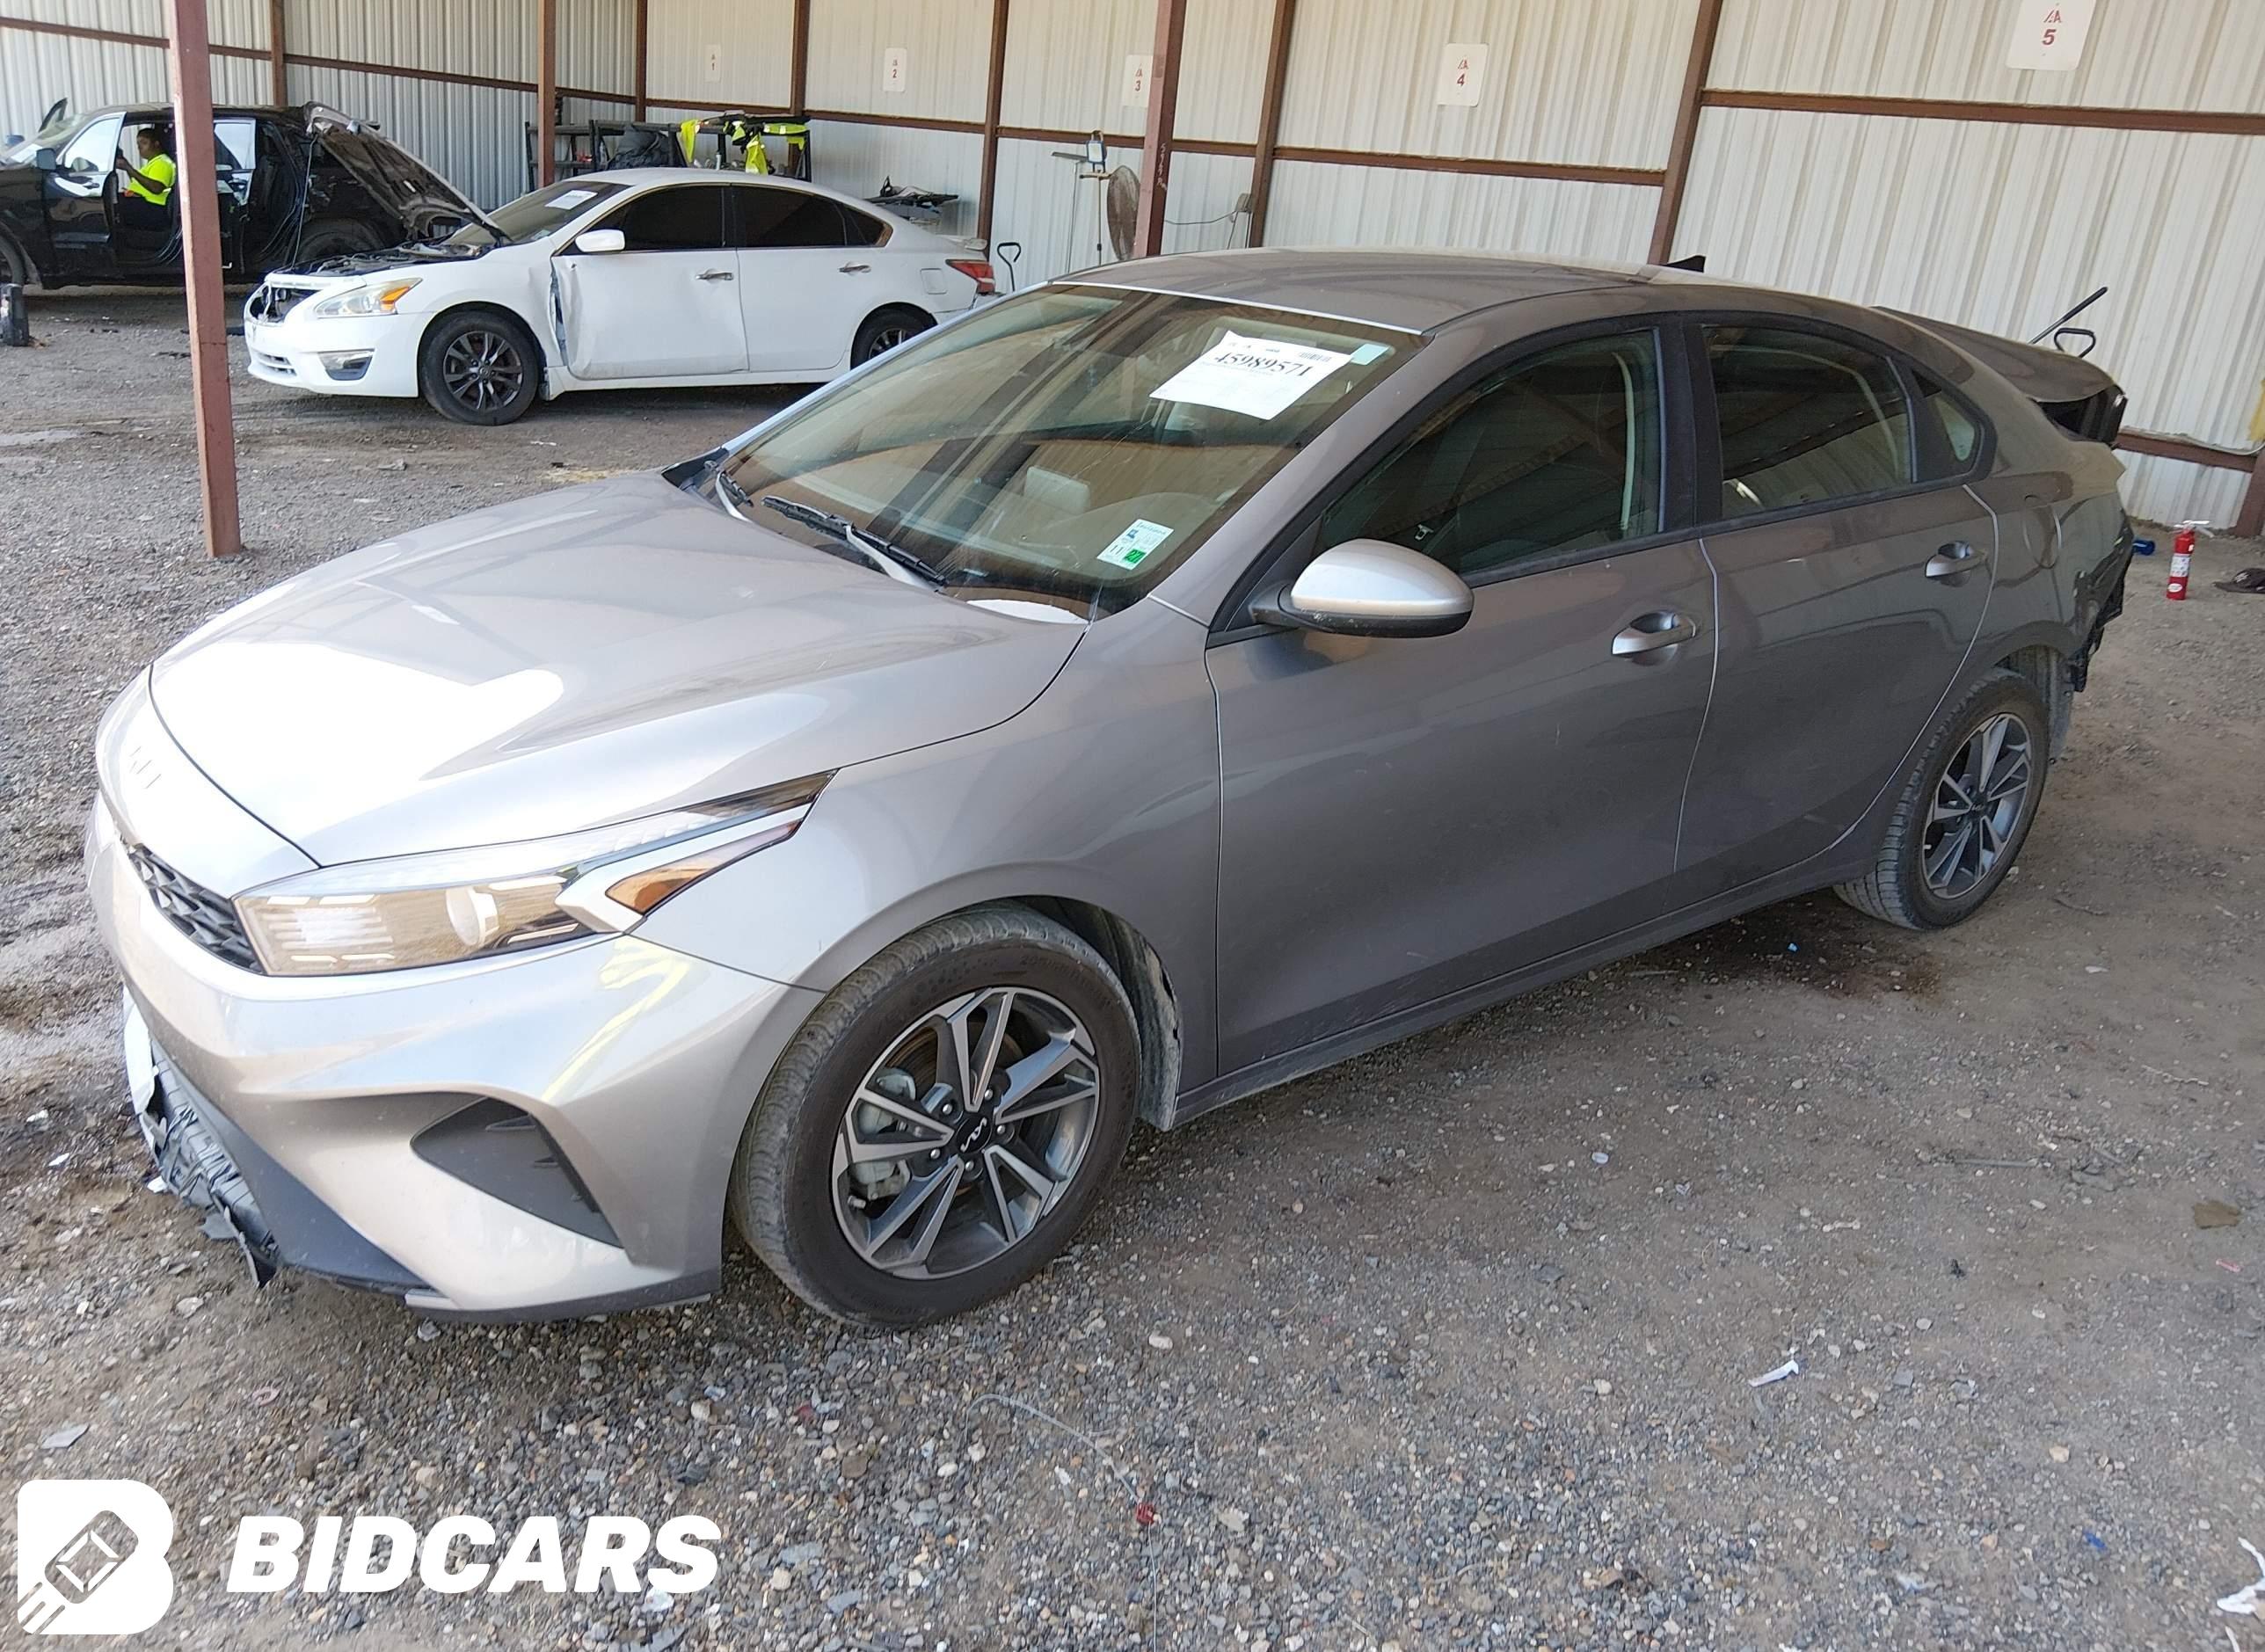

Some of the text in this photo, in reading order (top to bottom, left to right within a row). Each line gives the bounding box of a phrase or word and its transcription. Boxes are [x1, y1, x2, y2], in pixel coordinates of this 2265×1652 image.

[2041, 28, 2057, 46] 5
[892, 69, 897, 78] 2
[1457, 73, 1465, 87] 4
[1135, 80, 1141, 91] 3
[1213, 352, 1314, 377] 45989571
